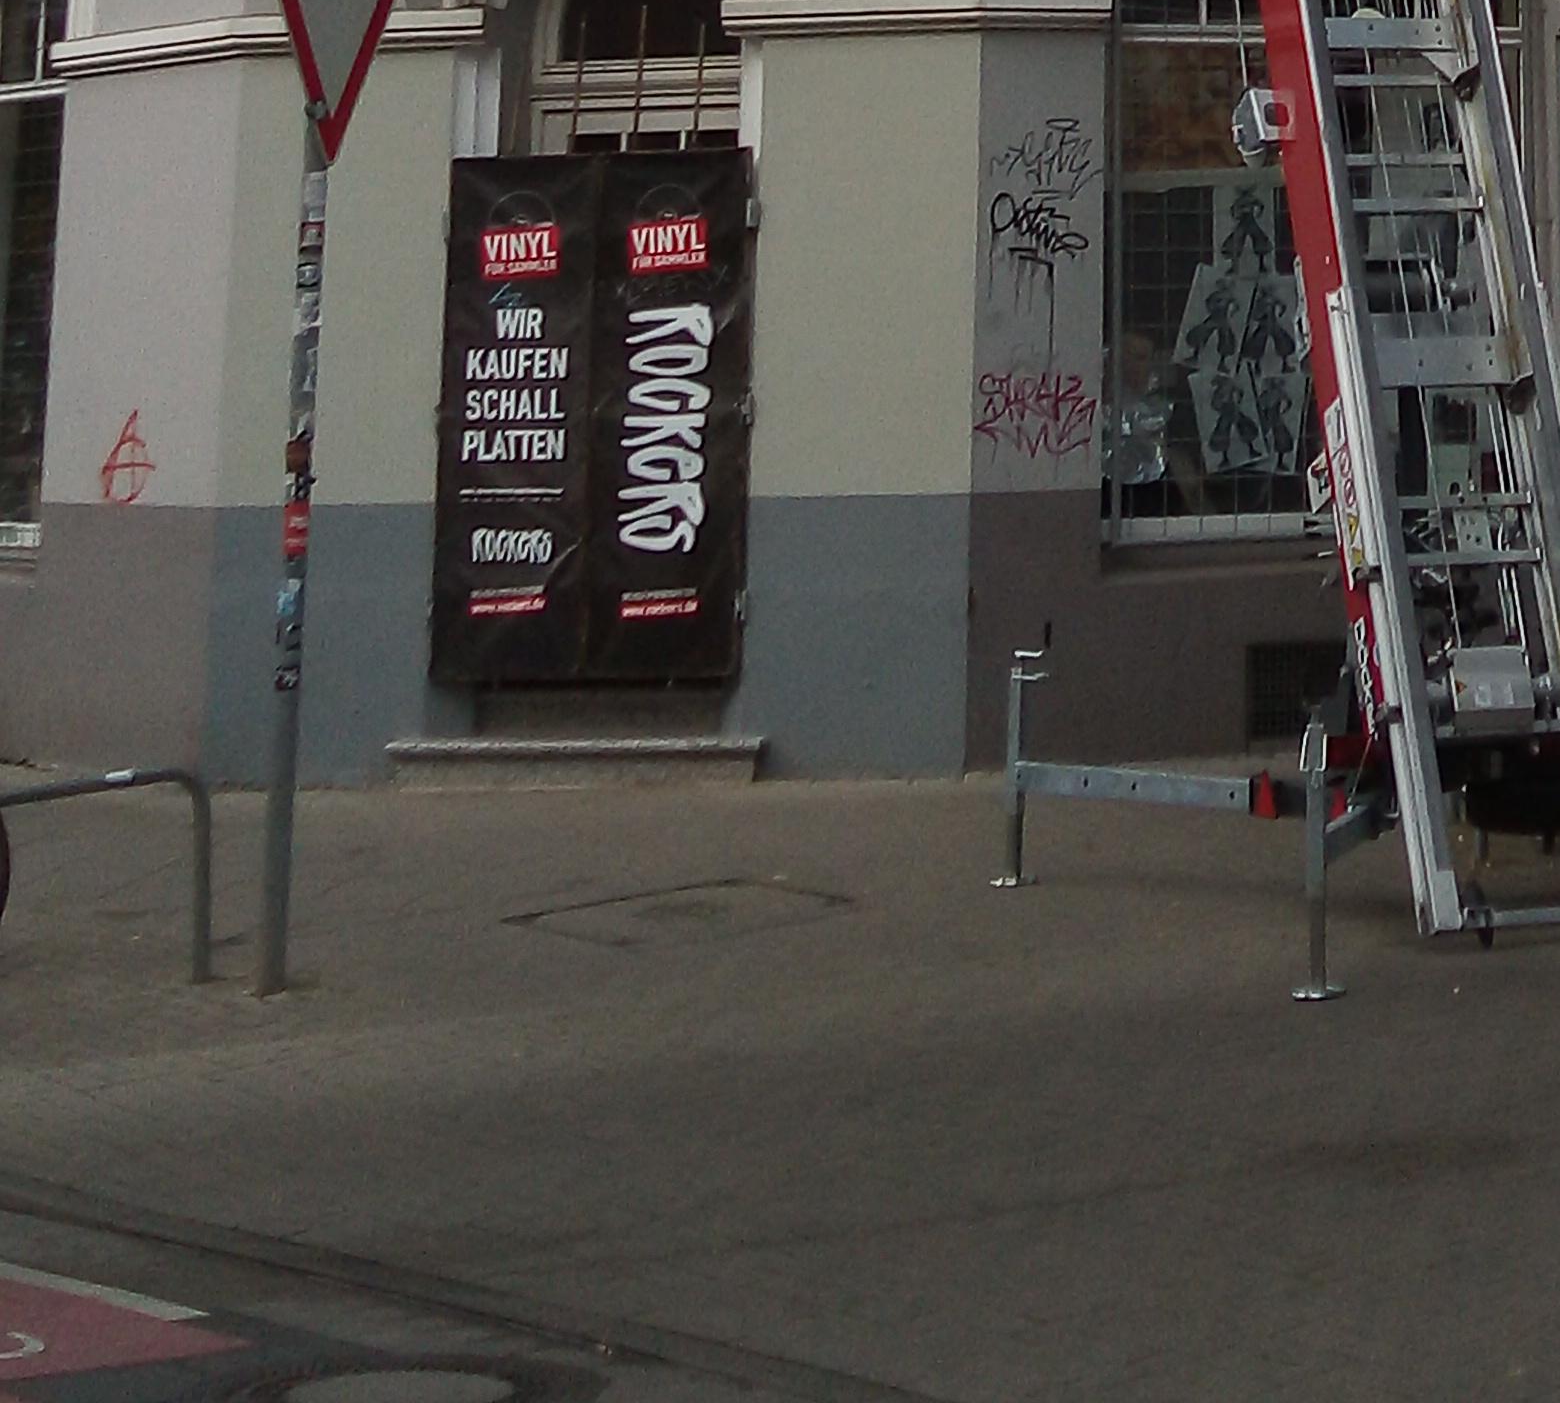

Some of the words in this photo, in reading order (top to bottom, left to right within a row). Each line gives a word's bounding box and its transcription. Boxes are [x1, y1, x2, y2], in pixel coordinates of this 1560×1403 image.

[485, 229, 557, 261] VINYL
[632, 223, 705, 254] VINYL
[496, 307, 543, 340] WIR
[465, 347, 569, 381] KAUFEN
[464, 387, 566, 421] SCHALL
[460, 428, 566, 462] PLATTEN
